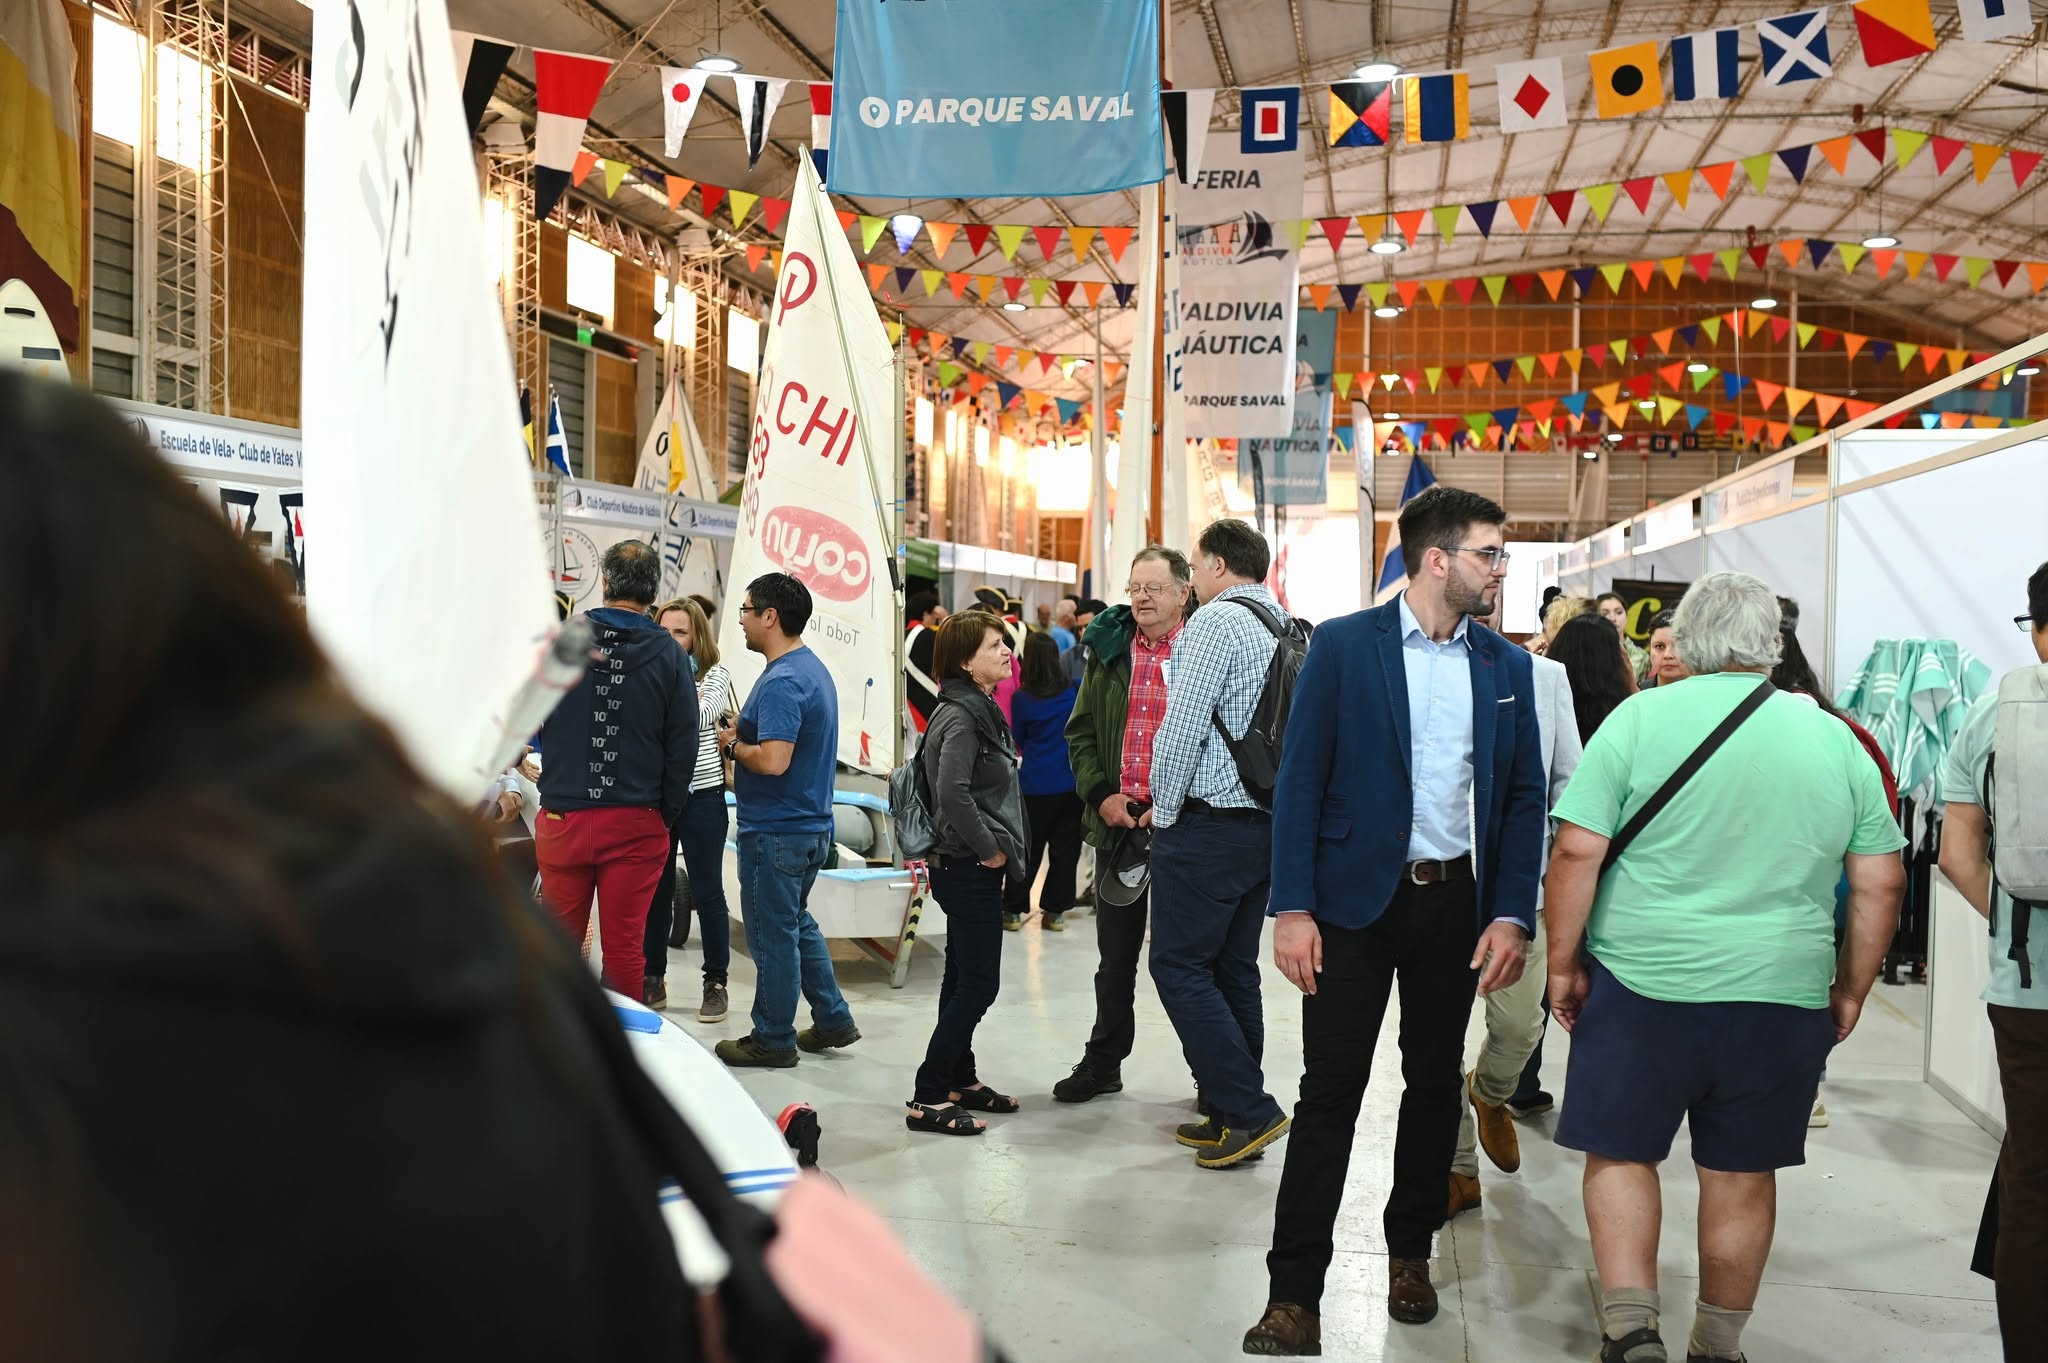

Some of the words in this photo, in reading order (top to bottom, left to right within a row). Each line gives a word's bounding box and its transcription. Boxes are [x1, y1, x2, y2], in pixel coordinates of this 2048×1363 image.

[895, 97, 1025, 127] PARQUE
[1030, 91, 1134, 122] SAVAL
[1193, 170, 1261, 189] FERIA
[1182, 247, 1234, 257] ALDIVIA
[1181, 302, 1283, 321] ALDIVIA
[1185, 395, 1239, 407] ARQUE
[1240, 395, 1286, 406] SAVAL
[776, 381, 857, 466] CHI
[160, 430, 197, 453] Escuela
[199, 436, 211, 455] de
[239, 442, 258, 461] Club
[260, 445, 271, 463] de
[272, 447, 294, 467] Yates
